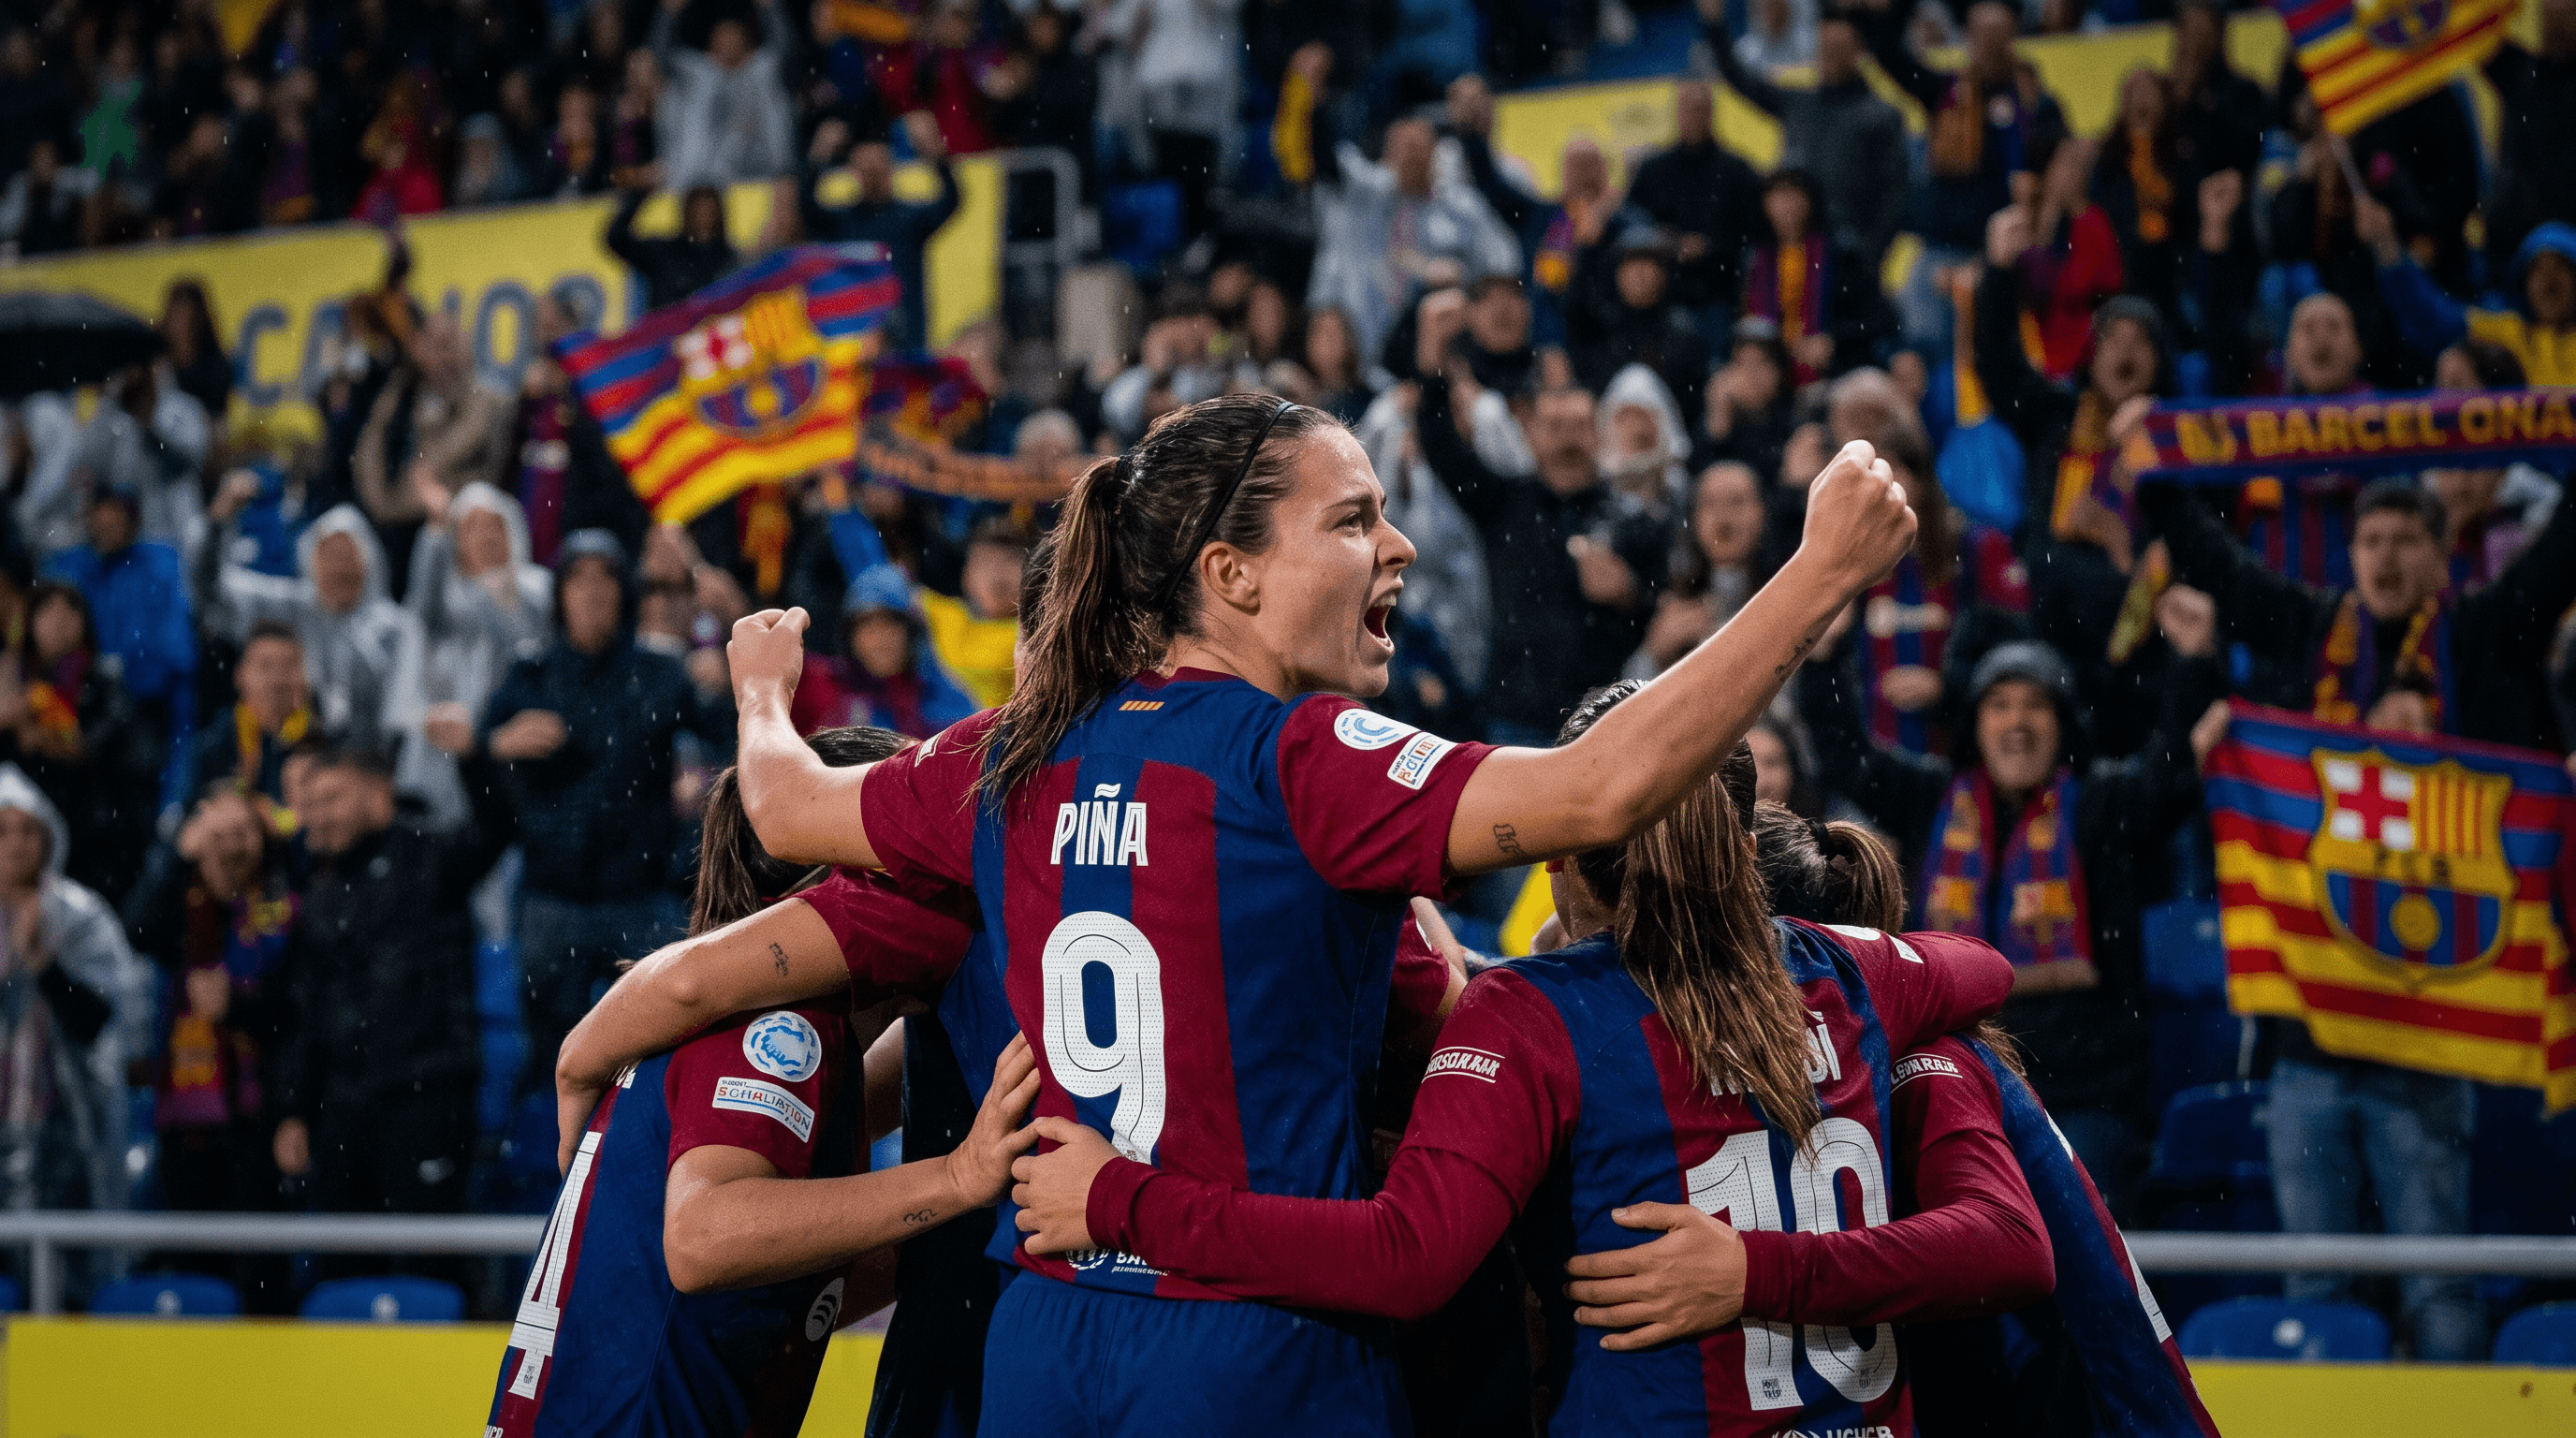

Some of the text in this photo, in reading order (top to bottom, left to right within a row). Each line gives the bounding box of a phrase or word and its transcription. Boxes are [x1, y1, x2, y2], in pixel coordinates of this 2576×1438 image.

[1050, 783, 1149, 867] PIÑA
[1042, 911, 1166, 1164] 9
[508, 1131, 602, 1400] 4
[1687, 1117, 1898, 1411] 10
